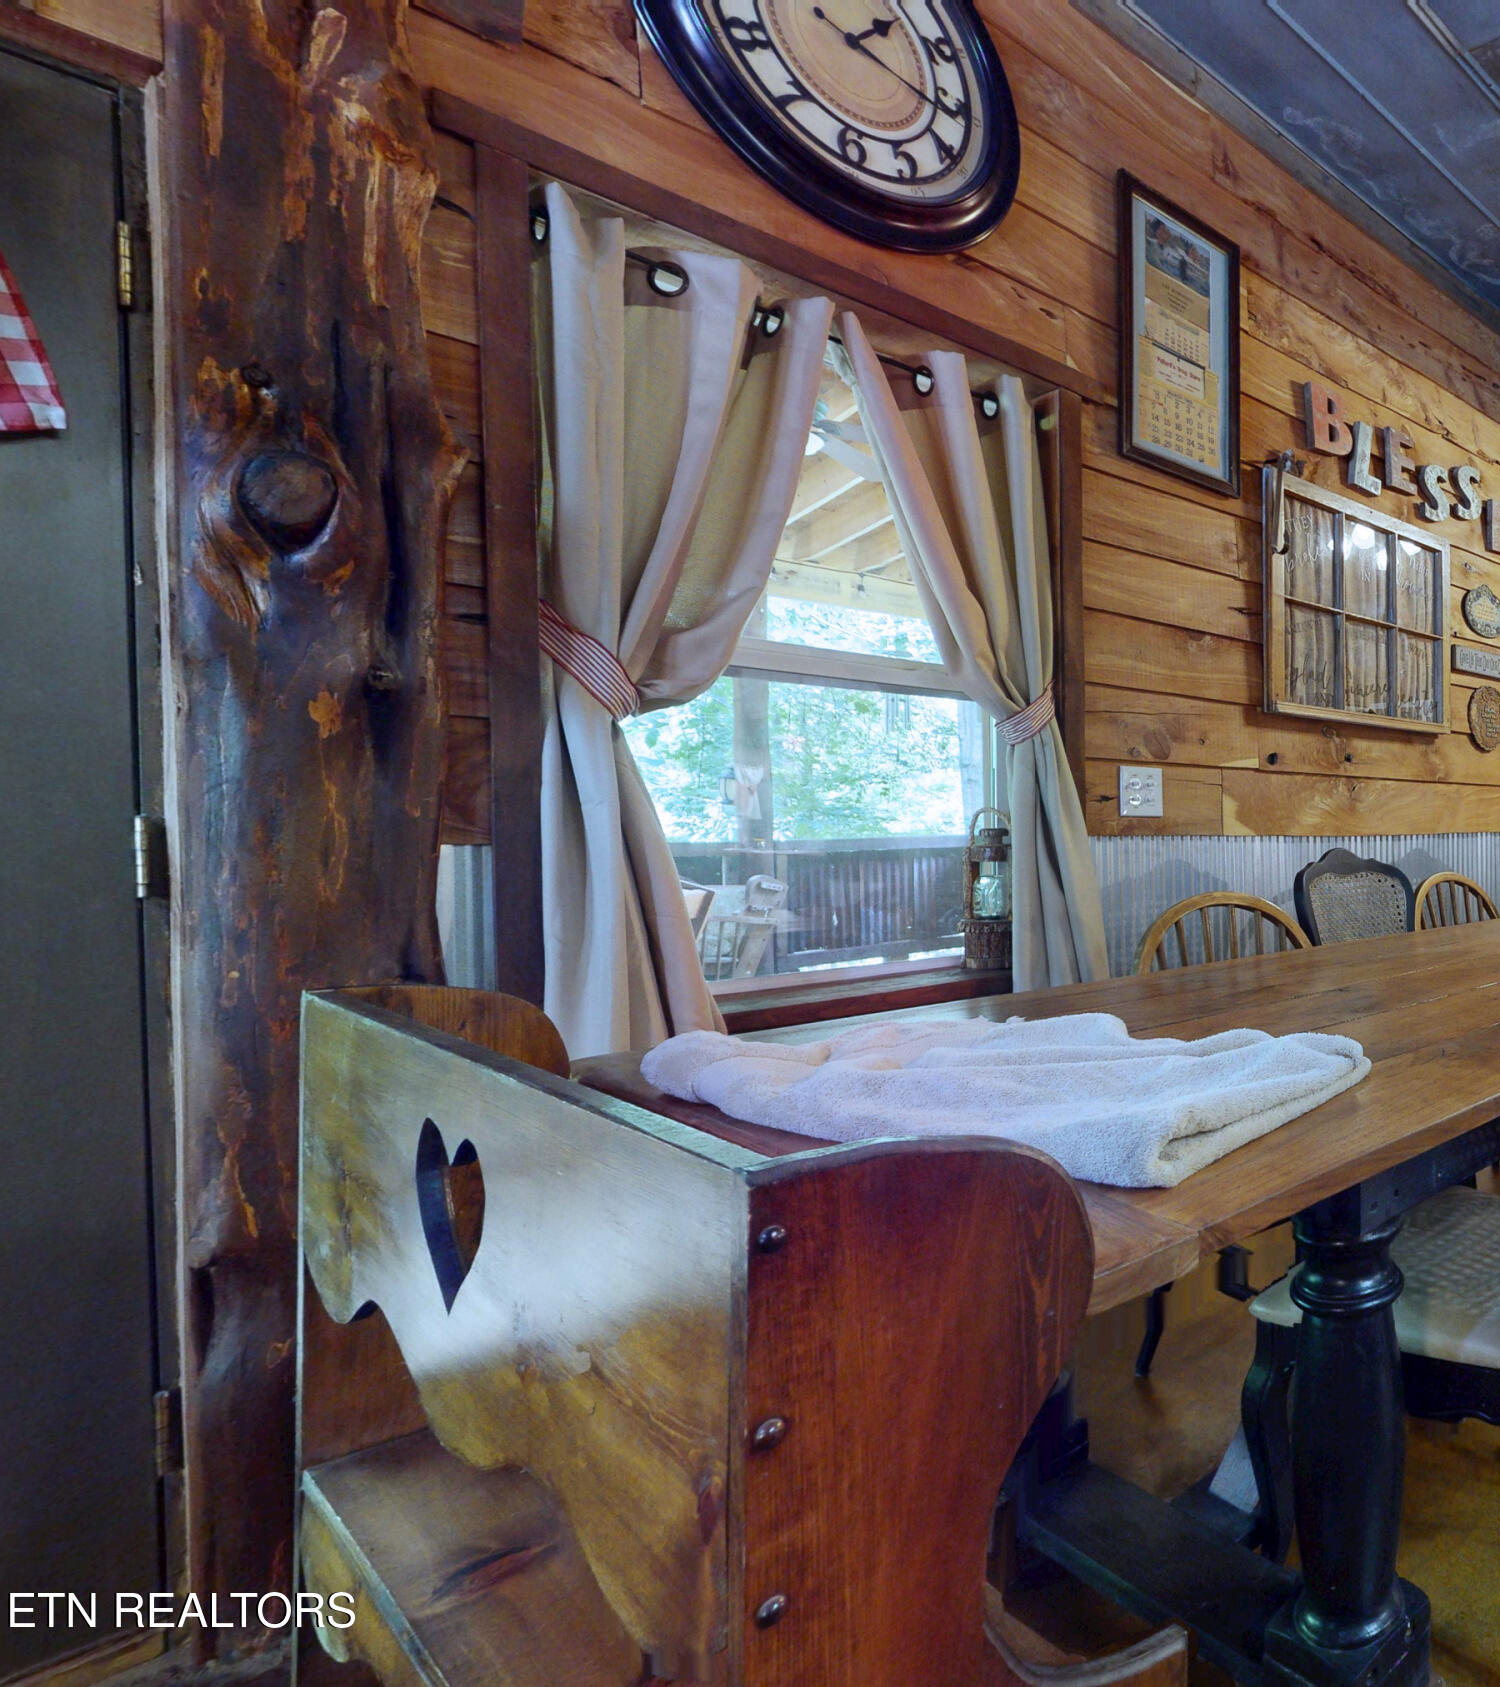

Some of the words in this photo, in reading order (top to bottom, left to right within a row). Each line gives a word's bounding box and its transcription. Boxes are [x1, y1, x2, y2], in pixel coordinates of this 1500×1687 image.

[723, 16, 773, 51] 8
[837, 126, 867, 166] 6
[890, 141, 918, 180] 5
